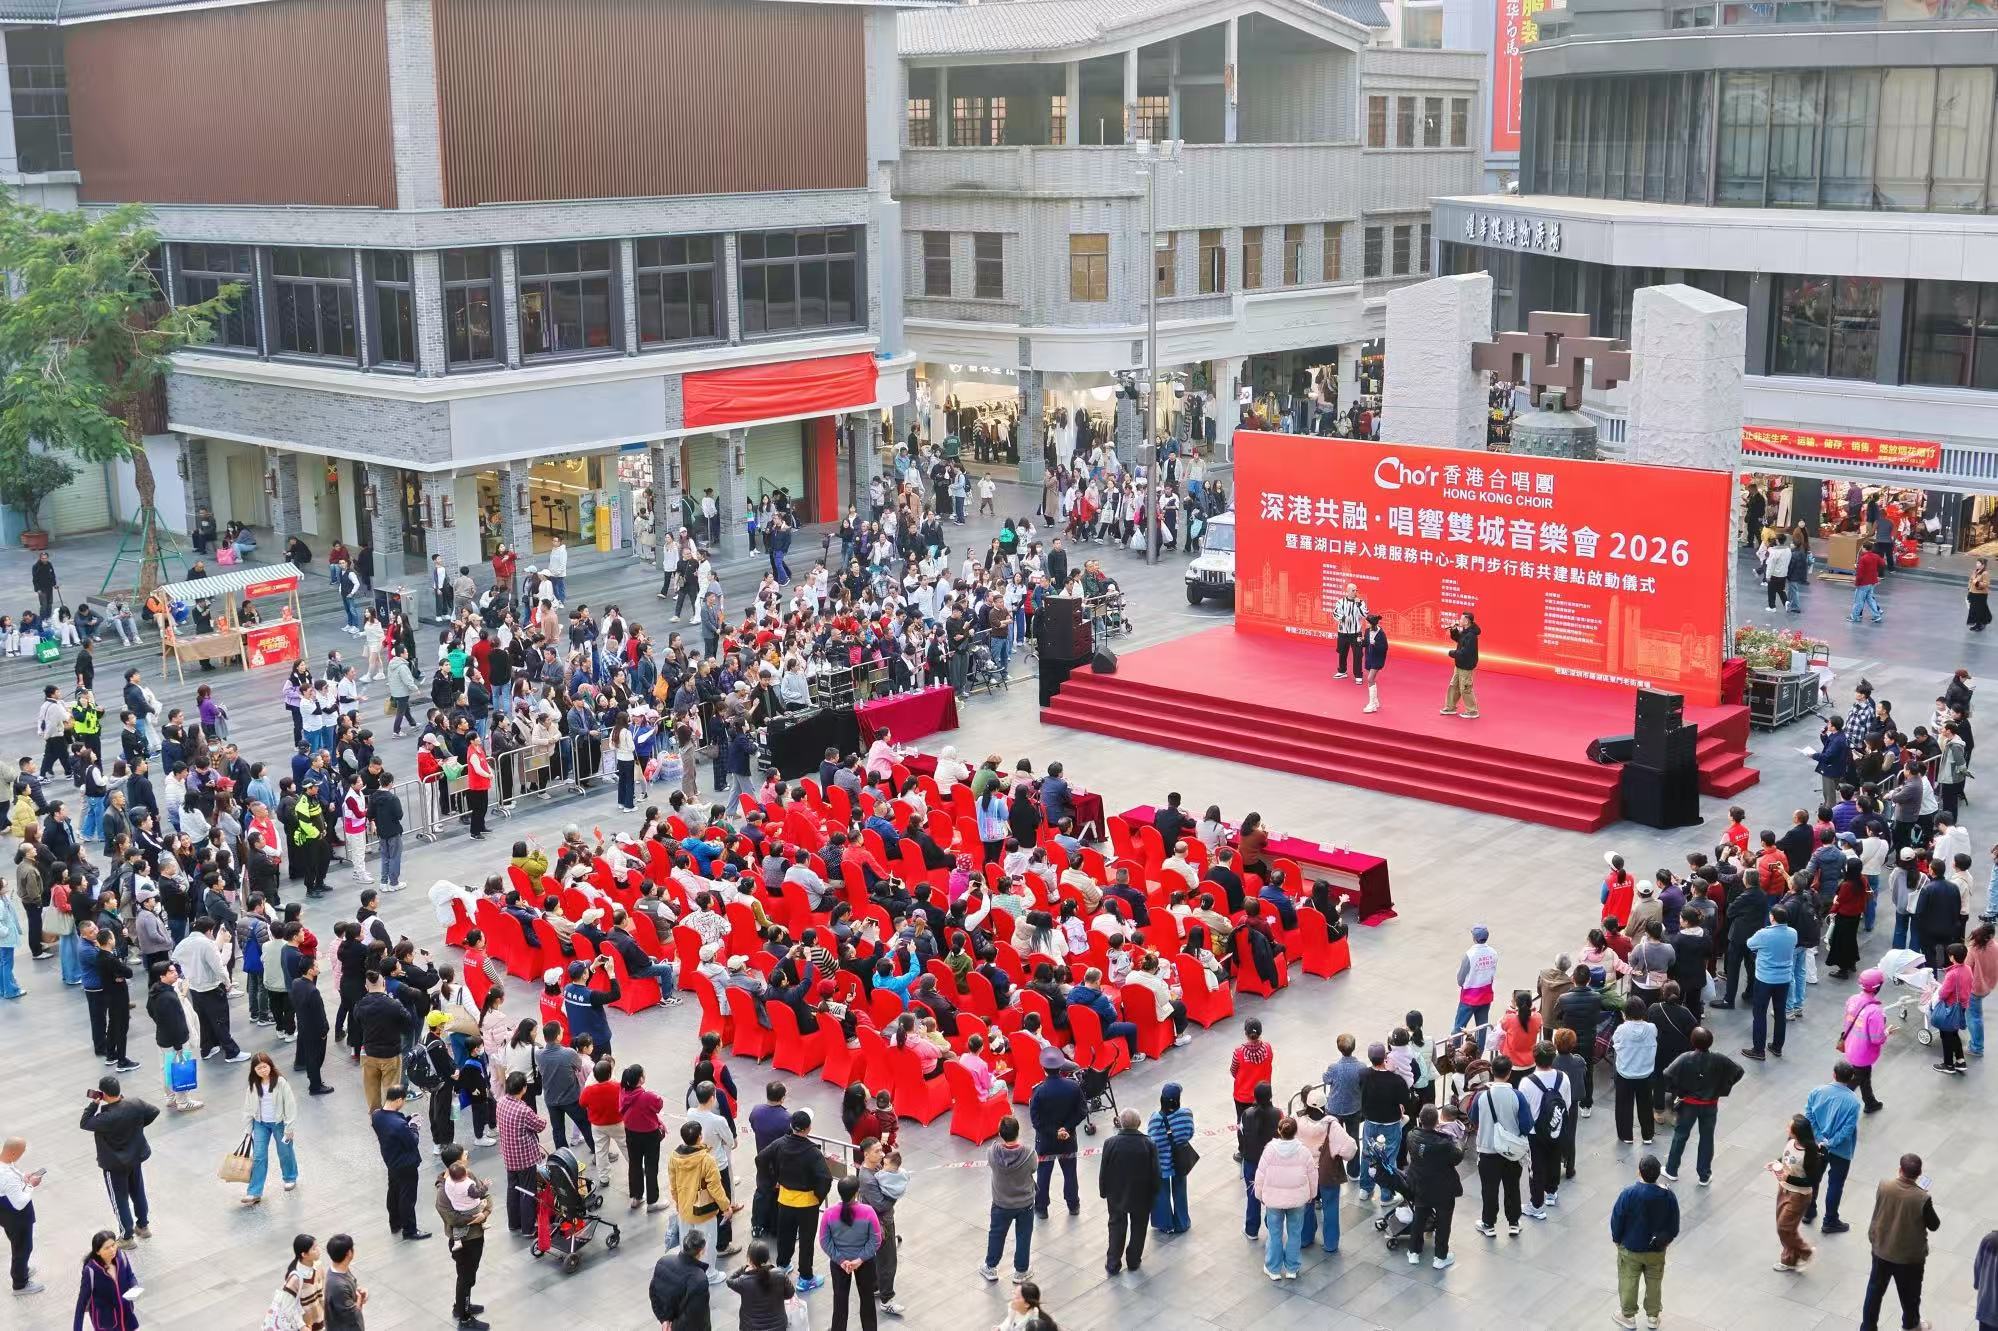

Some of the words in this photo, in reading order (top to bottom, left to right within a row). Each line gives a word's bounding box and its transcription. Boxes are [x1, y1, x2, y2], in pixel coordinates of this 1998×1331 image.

[1504, 0, 1519, 55] 华白馬
[1443, 464, 1554, 495] 香港合唱團
[1443, 487, 1476, 500] HONG
[1479, 492, 1513, 505] KONG
[1515, 495, 1553, 509] CHOIR
[1260, 491, 1600, 558] 深港共融·唱響雙城音樂會
[1609, 532, 1689, 567] 2026
